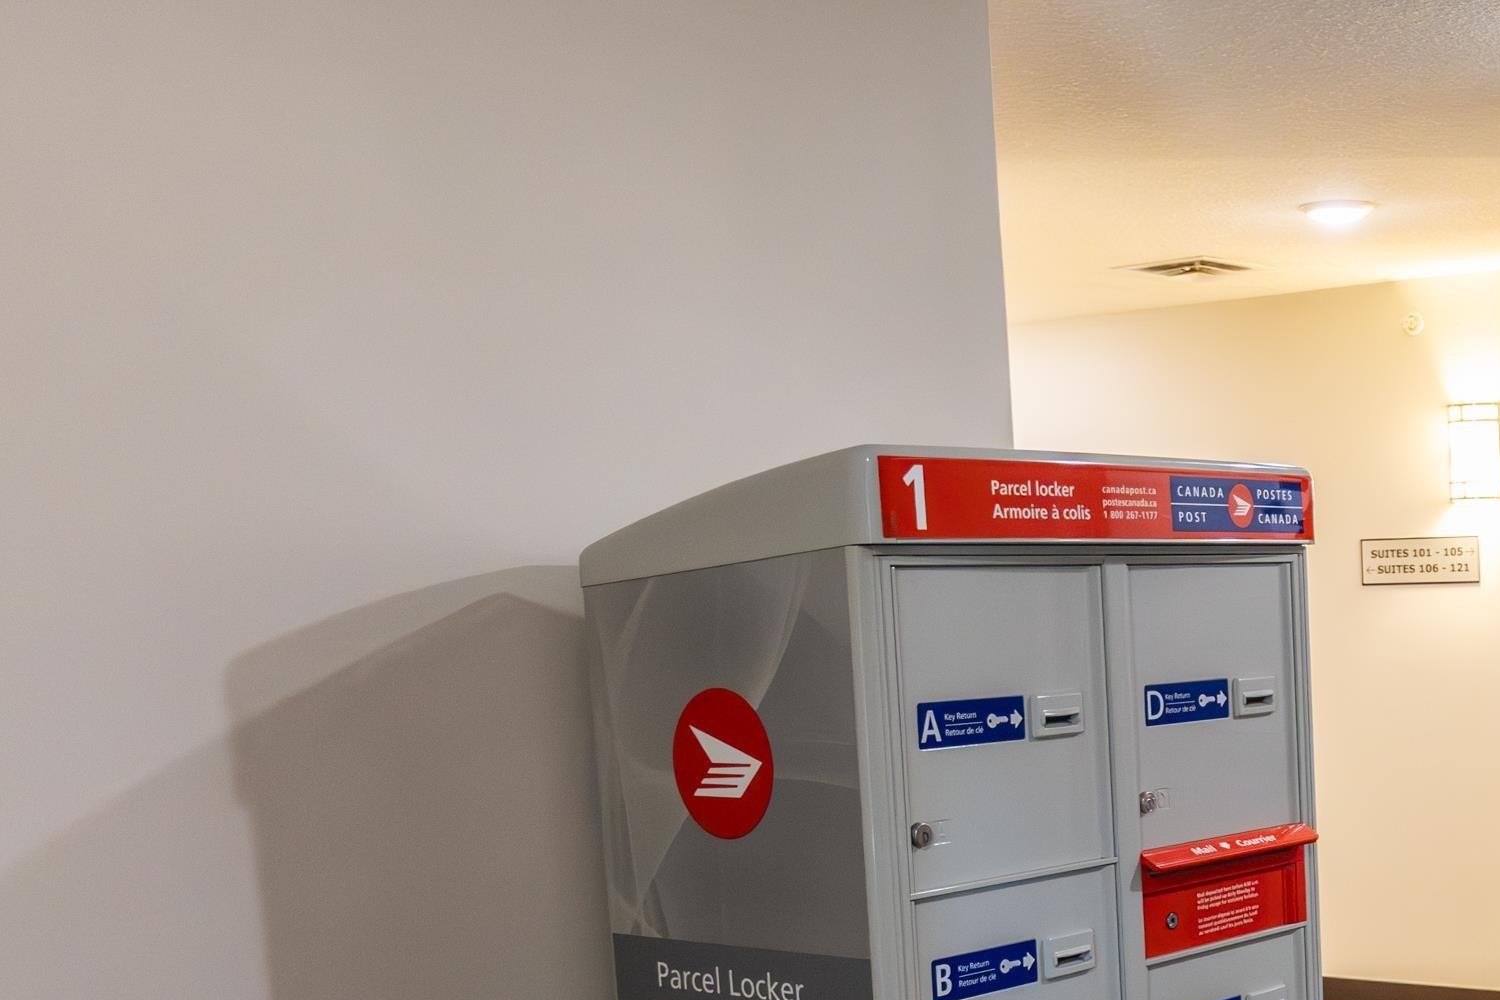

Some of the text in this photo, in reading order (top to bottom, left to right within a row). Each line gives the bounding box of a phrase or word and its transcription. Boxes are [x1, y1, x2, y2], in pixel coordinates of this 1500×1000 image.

[991, 480, 1075, 497] Parcel locker
[1102, 485, 1157, 496] canadapost.ca
[1177, 485, 1225, 498] CANADA
[1256, 489, 1293, 501] POSTES
[902, 464, 928, 531] 1
[1102, 498, 1158, 508] postescanada.ca
[993, 504, 1091, 520] Armoire à colis
[1103, 510, 1108, 519] 1
[1110, 510, 1124, 520] 800
[1178, 511, 1207, 523] POST
[1258, 513, 1299, 525] CANADA
[1370, 548, 1409, 559] SUITES
[1413, 548, 1432, 558] 101
[1444, 547, 1464, 557] 105
[1377, 564, 1416, 574] SUITES
[1419, 563, 1439, 573] 106
[1450, 563, 1470, 573] 121
[1146, 690, 1165, 721] D
[944, 711, 977, 723] Key Return
[920, 710, 943, 744] A
[945, 728, 966, 737] Retour
[966, 727, 975, 735] de
[1190, 833, 1277, 856] Mail Courrier
[957, 960, 990, 974] Key Return
[656, 960, 721, 995] Parcel
[935, 964, 953, 997] B
[958, 977, 979, 988] Retour
[979, 975, 988, 983] de
